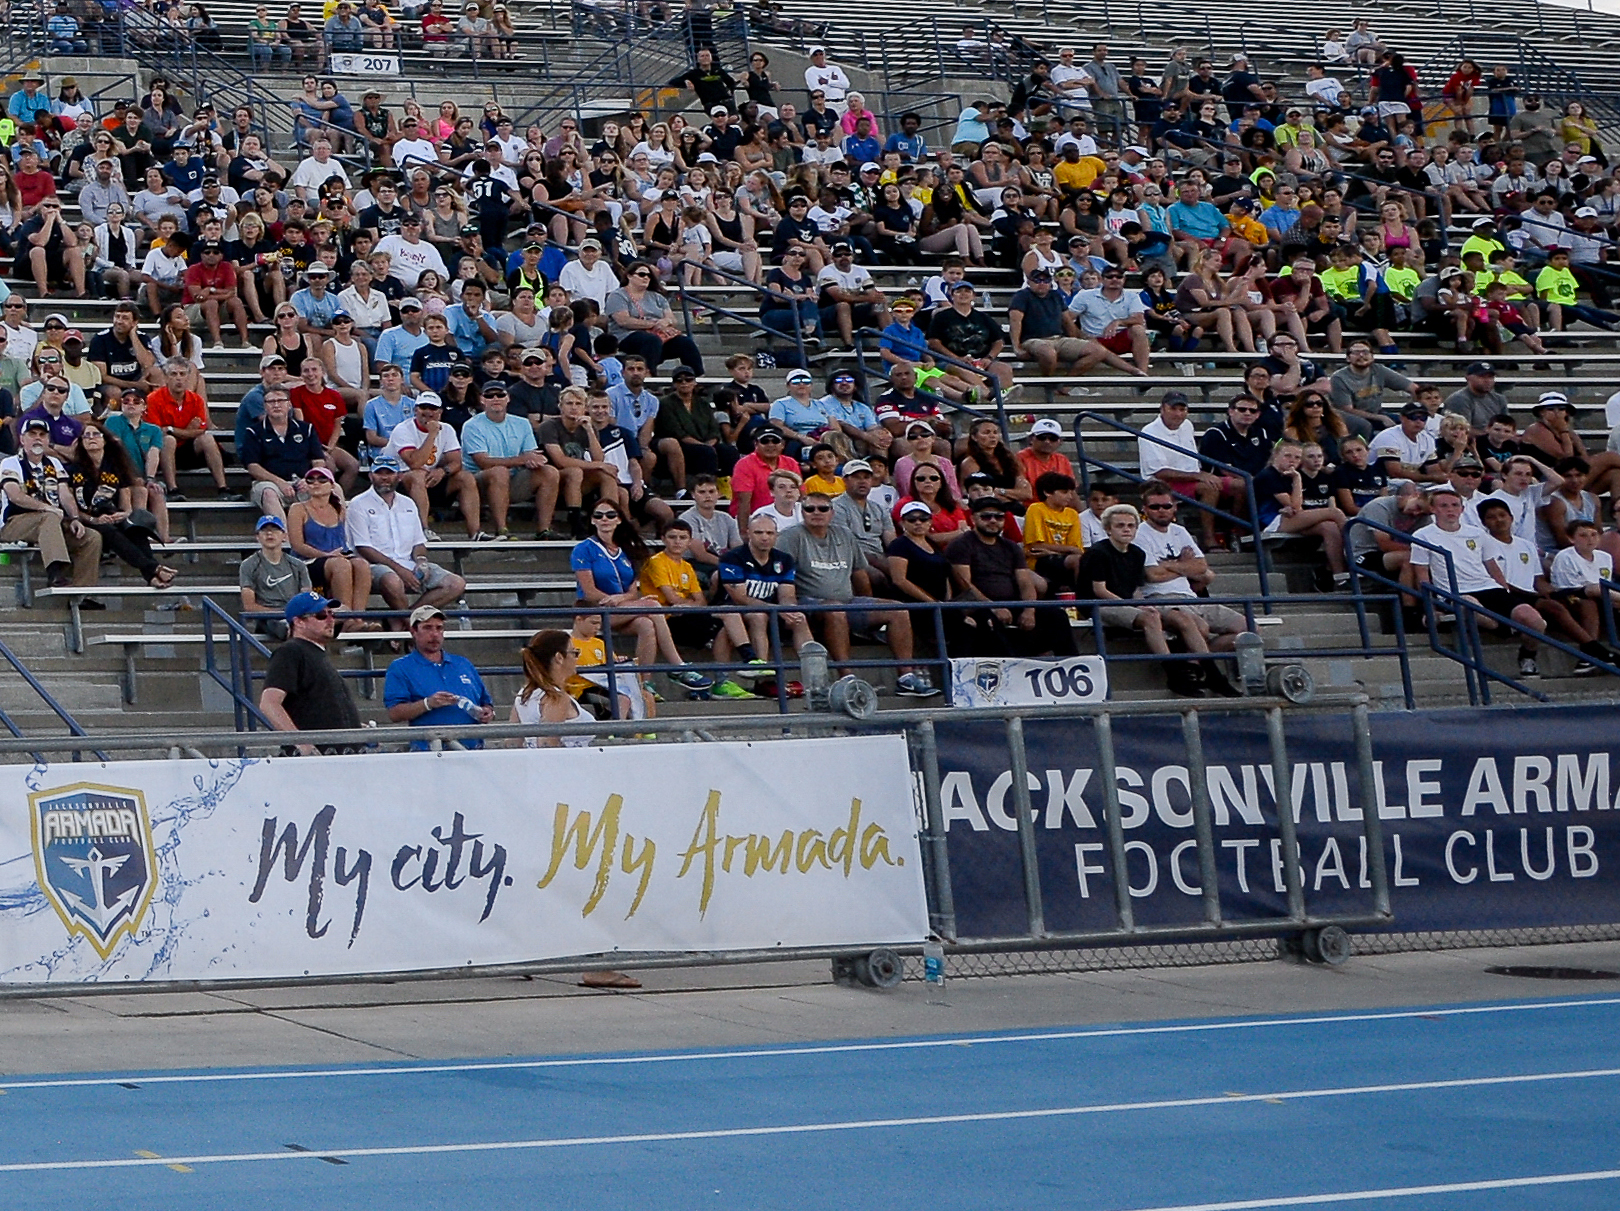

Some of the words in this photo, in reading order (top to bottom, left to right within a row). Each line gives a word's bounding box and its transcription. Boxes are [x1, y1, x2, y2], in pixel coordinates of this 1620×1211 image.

[362, 57, 392, 71] 207
[1025, 664, 1094, 698] 106
[1460, 752, 1620, 817] ARM
[48, 800, 128, 811] JACKSONVILLE
[43, 808, 142, 850] ARMADA
[54, 836, 105, 845] FOOTBALL
[109, 835, 131, 844] CLUB
[248, 804, 373, 948] My
[390, 811, 514, 924] city.
[538, 793, 656, 918] My
[676, 789, 906, 921] Armada.
[1444, 824, 1599, 885] CLUB
